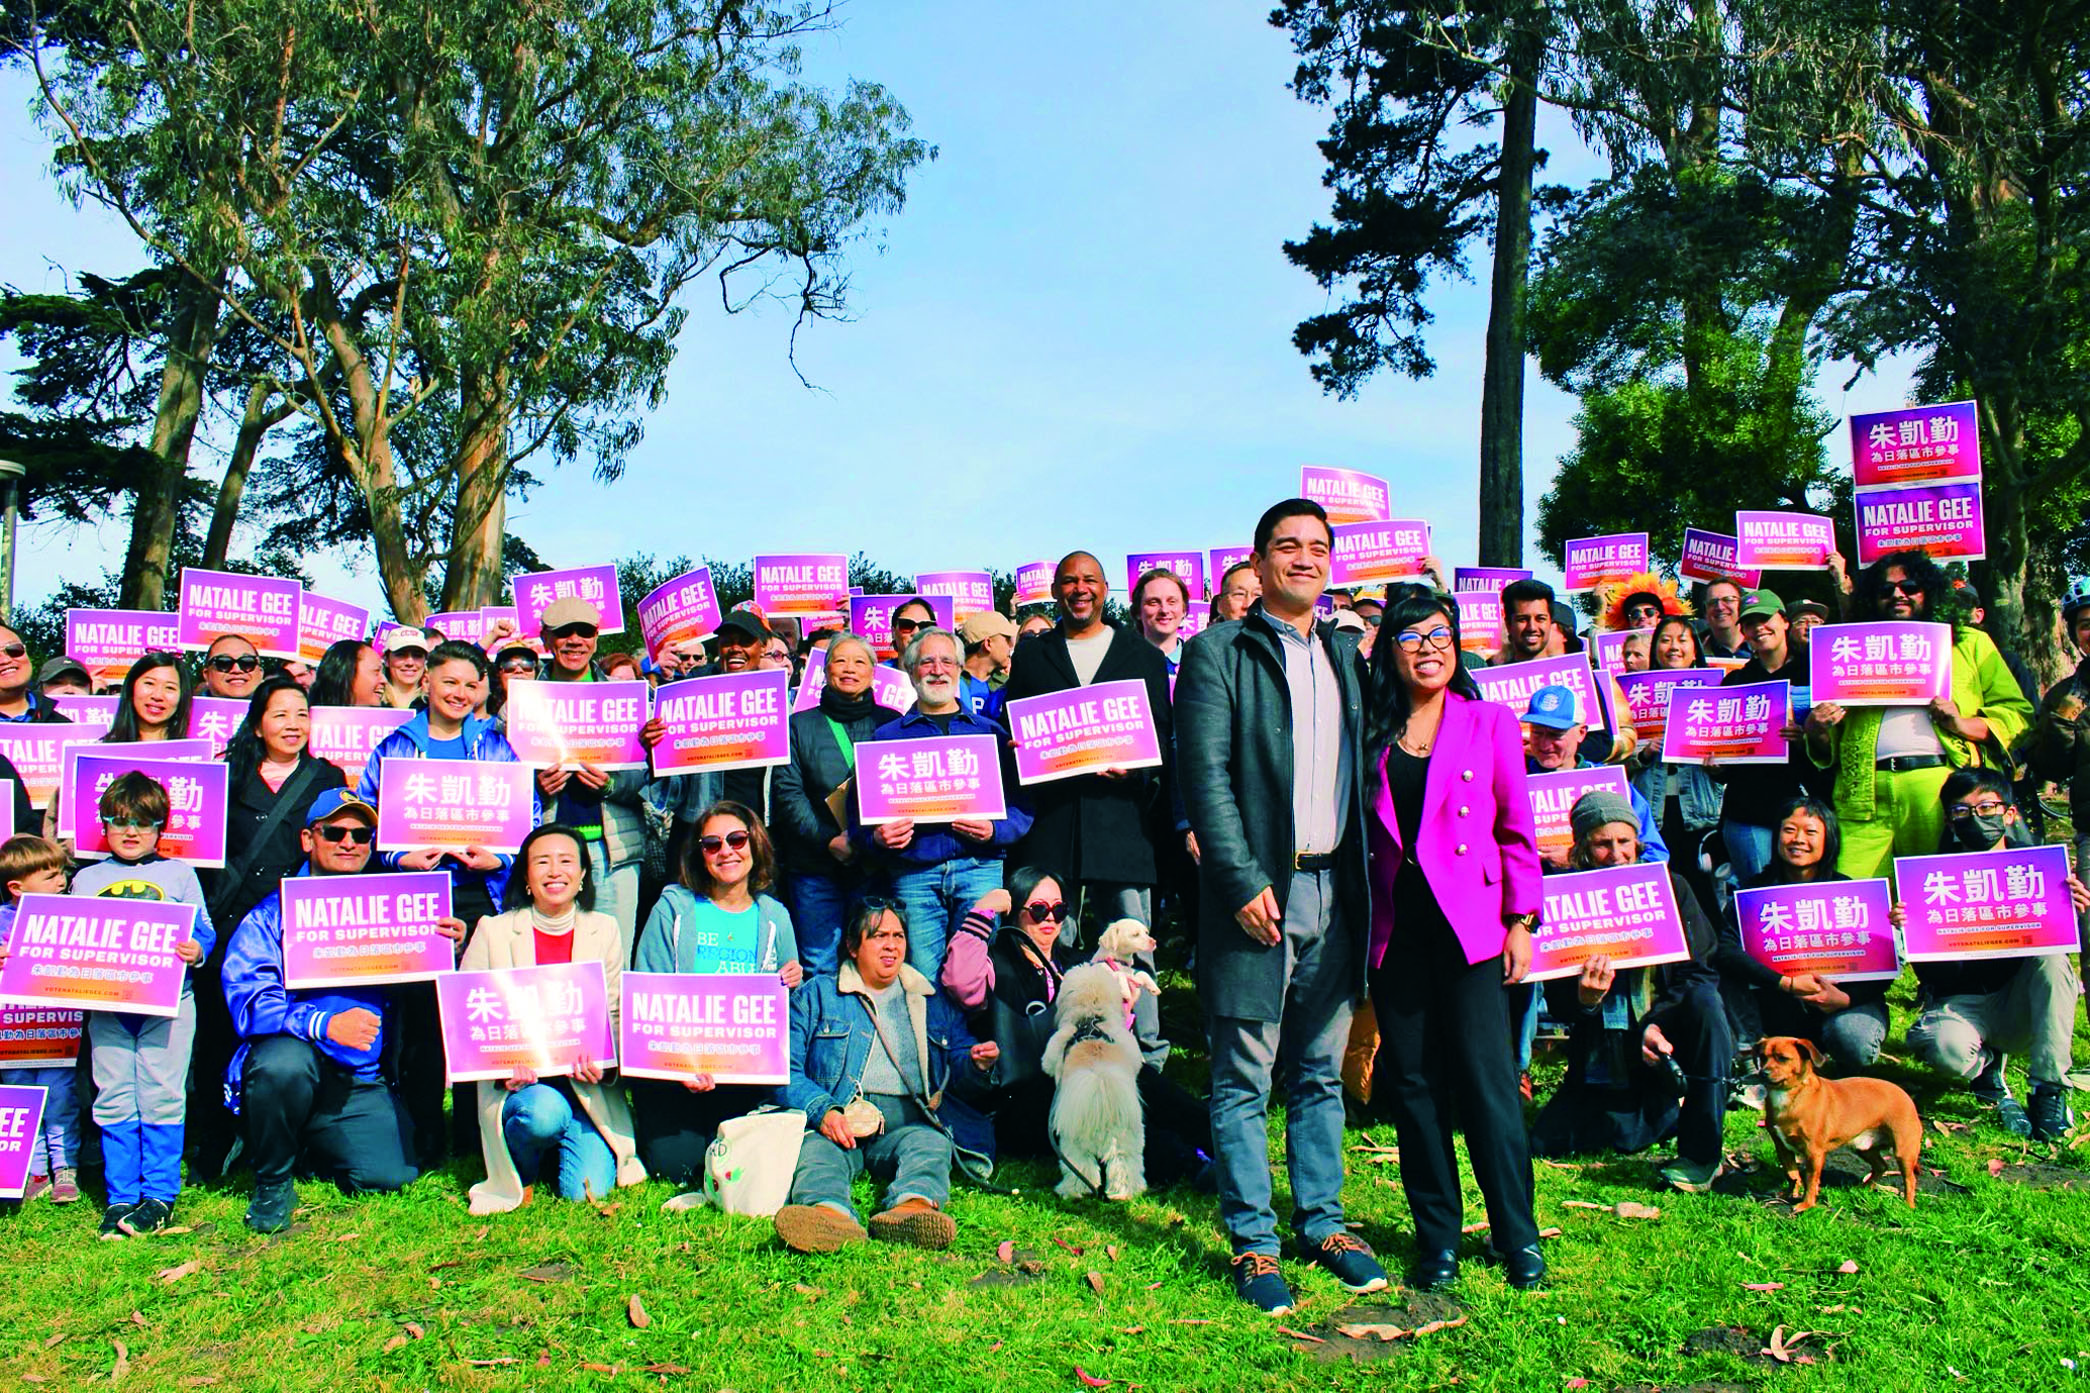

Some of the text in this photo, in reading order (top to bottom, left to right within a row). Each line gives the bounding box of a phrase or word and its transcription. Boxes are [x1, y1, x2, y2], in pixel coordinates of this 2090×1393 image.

[1869, 415, 1959, 449] 朱凱勤
[1307, 478, 1386, 503] NATALIE GEE
[1863, 497, 1974, 527] NATALIE GEE
[1744, 522, 1829, 539] NATALIE GEE
[1865, 520, 1974, 537] FOR SUPERVISOR
[1334, 530, 1423, 553] NATALIE GEE
[1689, 539, 1734, 562] NATALIE
[1745, 537, 1764, 545] FOR
[1336, 546, 1424, 562] FOR SUPERVISOR
[1571, 544, 1642, 564] NATALIE GEE
[1571, 555, 1641, 571] FOR SUPERVISOR
[761, 565, 842, 584] NATALIE GEE
[1459, 578, 1502, 592] NATALIE
[761, 583, 842, 592] FOR SUPERVISOR
[922, 581, 989, 598] NATALIE GEE
[190, 585, 294, 615] NATALIE GEE
[643, 591, 680, 633] NATALIE
[680, 581, 709, 607] GEE
[1482, 603, 1499, 620] GEE
[189, 608, 292, 625] FOR SUPERVISOR
[332, 612, 361, 637] GEE
[75, 623, 143, 646] NATALIE
[147, 627, 178, 647] GEE
[75, 645, 98, 654] FOR
[1832, 633, 1932, 664] 朱凱勤
[1549, 668, 1585, 691] GEE
[602, 698, 640, 722] GEE
[661, 687, 779, 723] NATALIE GEE
[1686, 694, 1771, 725] 朱凱勤
[551, 723, 639, 734] UPERVISOR
[690, 715, 779, 733] SUPERVISOR
[1020, 696, 1143, 740] NATALIE GEE
[1024, 737, 1051, 751] FOR
[1055, 720, 1145, 743] SUPERVISOR
[878, 748, 980, 781] 朱凱勤
[403, 772, 511, 807] 朱凱勤
[1923, 864, 2046, 906] 朱凱勤
[1615, 881, 1664, 914] GEE
[295, 892, 440, 929] NATALIE GEE
[1760, 896, 1869, 934] 朱凱勤
[1926, 901, 2049, 925] 為日落區市參事
[23, 914, 181, 955] NATALIE GEE
[1559, 911, 1666, 935] SUPERVISOR
[296, 930, 329, 943] FOR
[697, 932, 719, 946] BE
[1763, 931, 1872, 953] 為日落區市參事
[18, 946, 174, 969] FOR SUPERVISOR
[466, 980, 584, 1023] 朱勤
[632, 992, 778, 1025] NATALIE GEE
[632, 1022, 778, 1039] FOR SUPERVISOR
